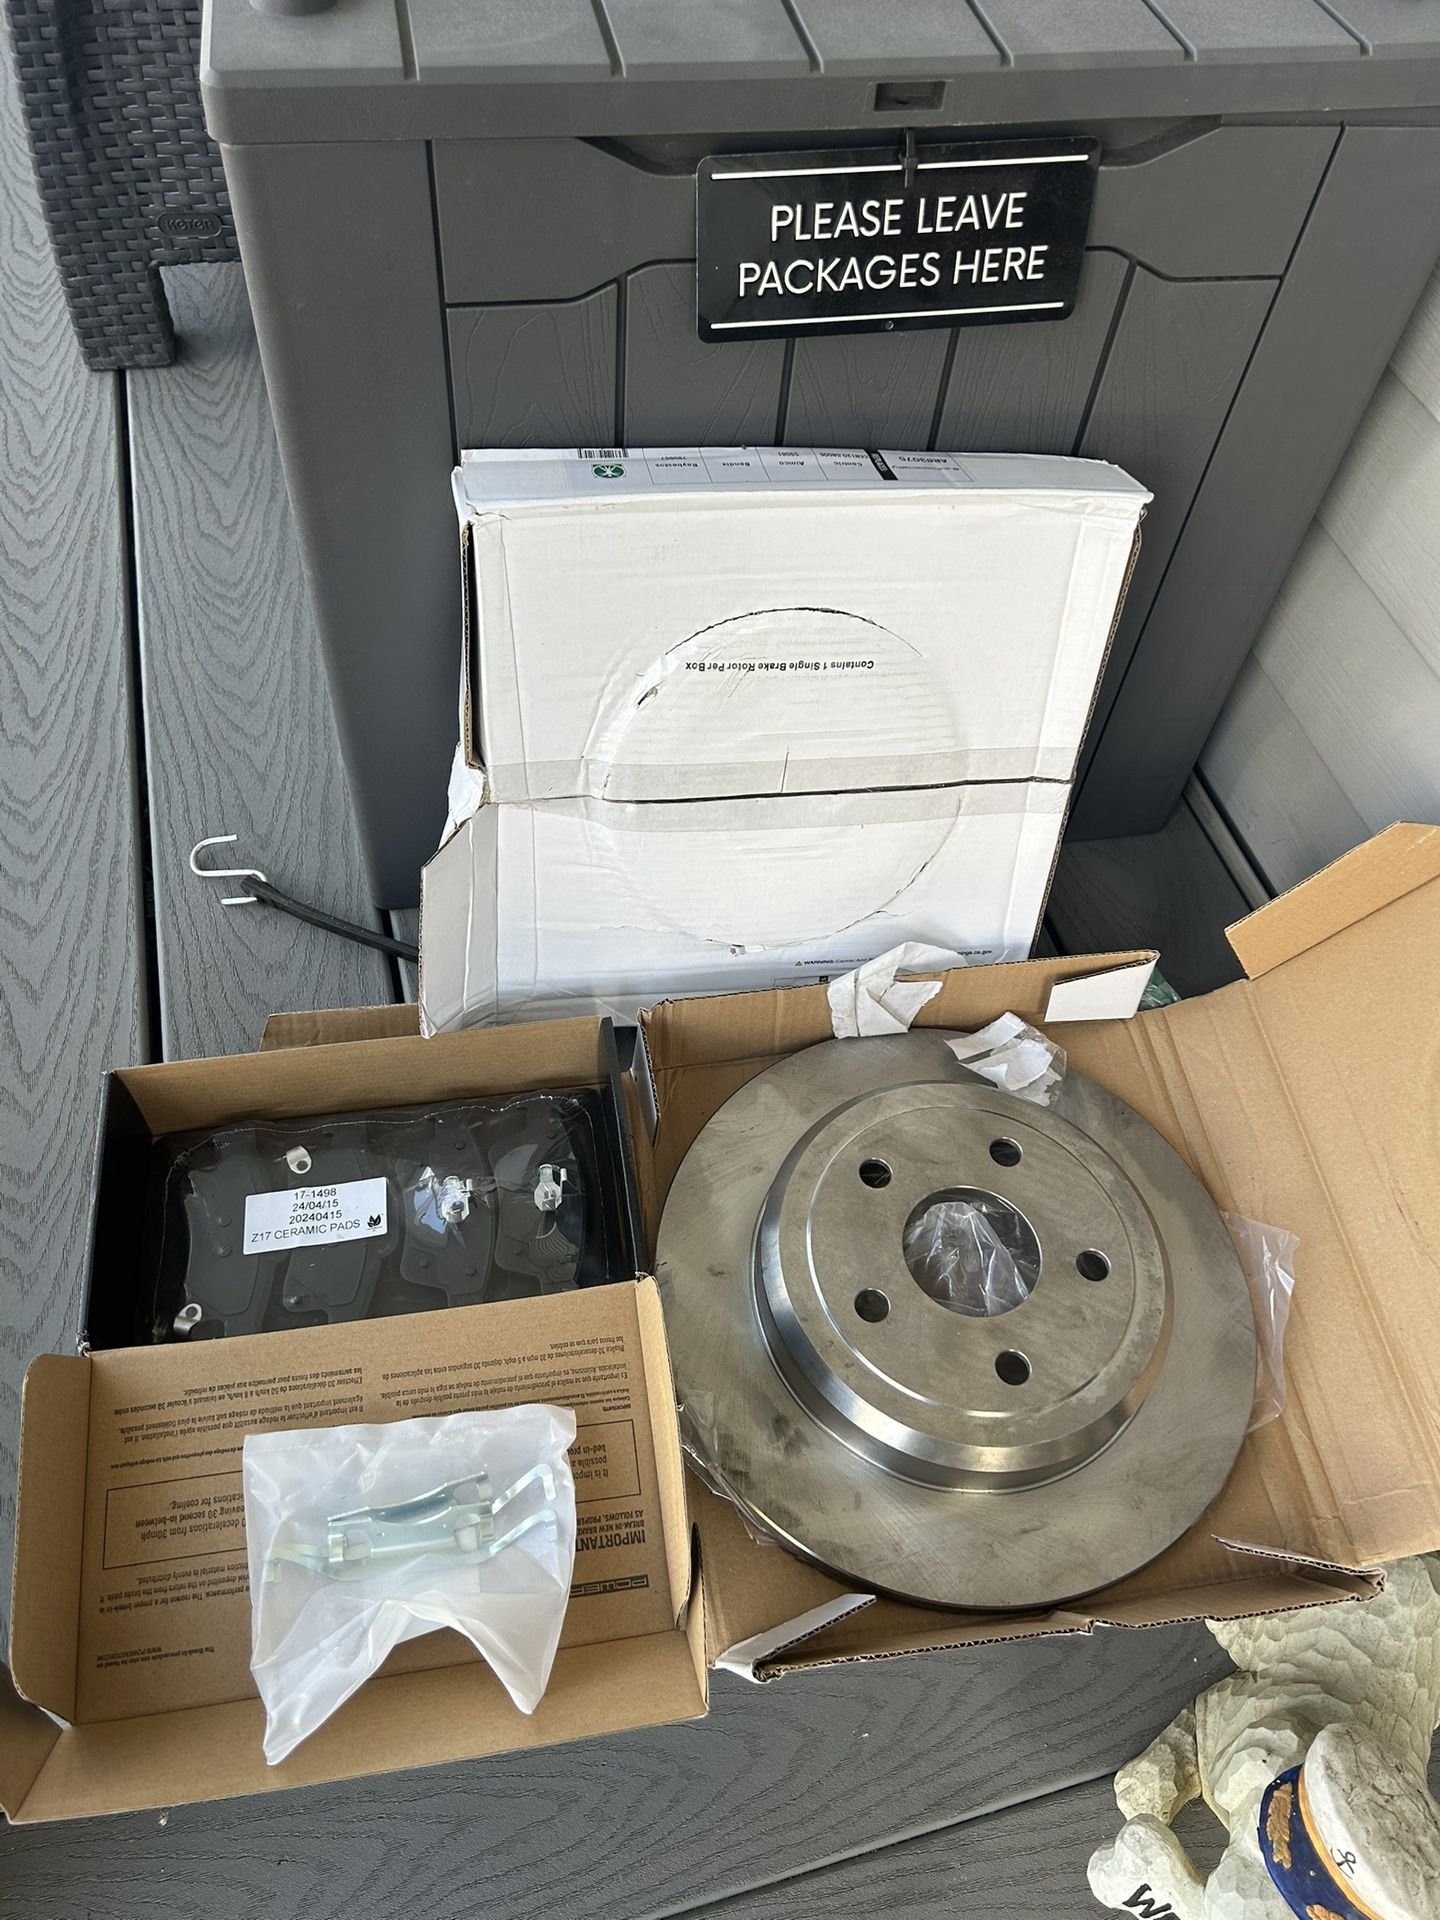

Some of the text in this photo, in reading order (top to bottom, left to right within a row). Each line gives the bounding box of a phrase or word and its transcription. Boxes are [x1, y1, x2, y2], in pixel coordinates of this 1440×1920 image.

[771, 192, 1027, 242] PLEASE LEAVE
[738, 245, 1048, 297] PACKAGES HERE
[685, 660, 874, 671] Contains 1 Single Brake Rotor Per Box
[294, 1188, 337, 1200] 17-1498
[292, 1199, 339, 1213] 24/04/15
[289, 1210, 342, 1225] 20240415
[251, 1231, 272, 1243] Z17
[274, 1225, 327, 1240] CERAMIC
[330, 1219, 361, 1232] PADS
[582, 1444, 606, 1455] bed-in
[578, 1454, 607, 1467] possible
[169, 1497, 211, 1510] for cooling.
[135, 1505, 245, 1527] eaving 30 second in-between
[140, 1519, 240, 1541] decelerations from 30mph
[598, 1523, 613, 1533] NEW
[615, 1519, 644, 1531] BREAK-IN
